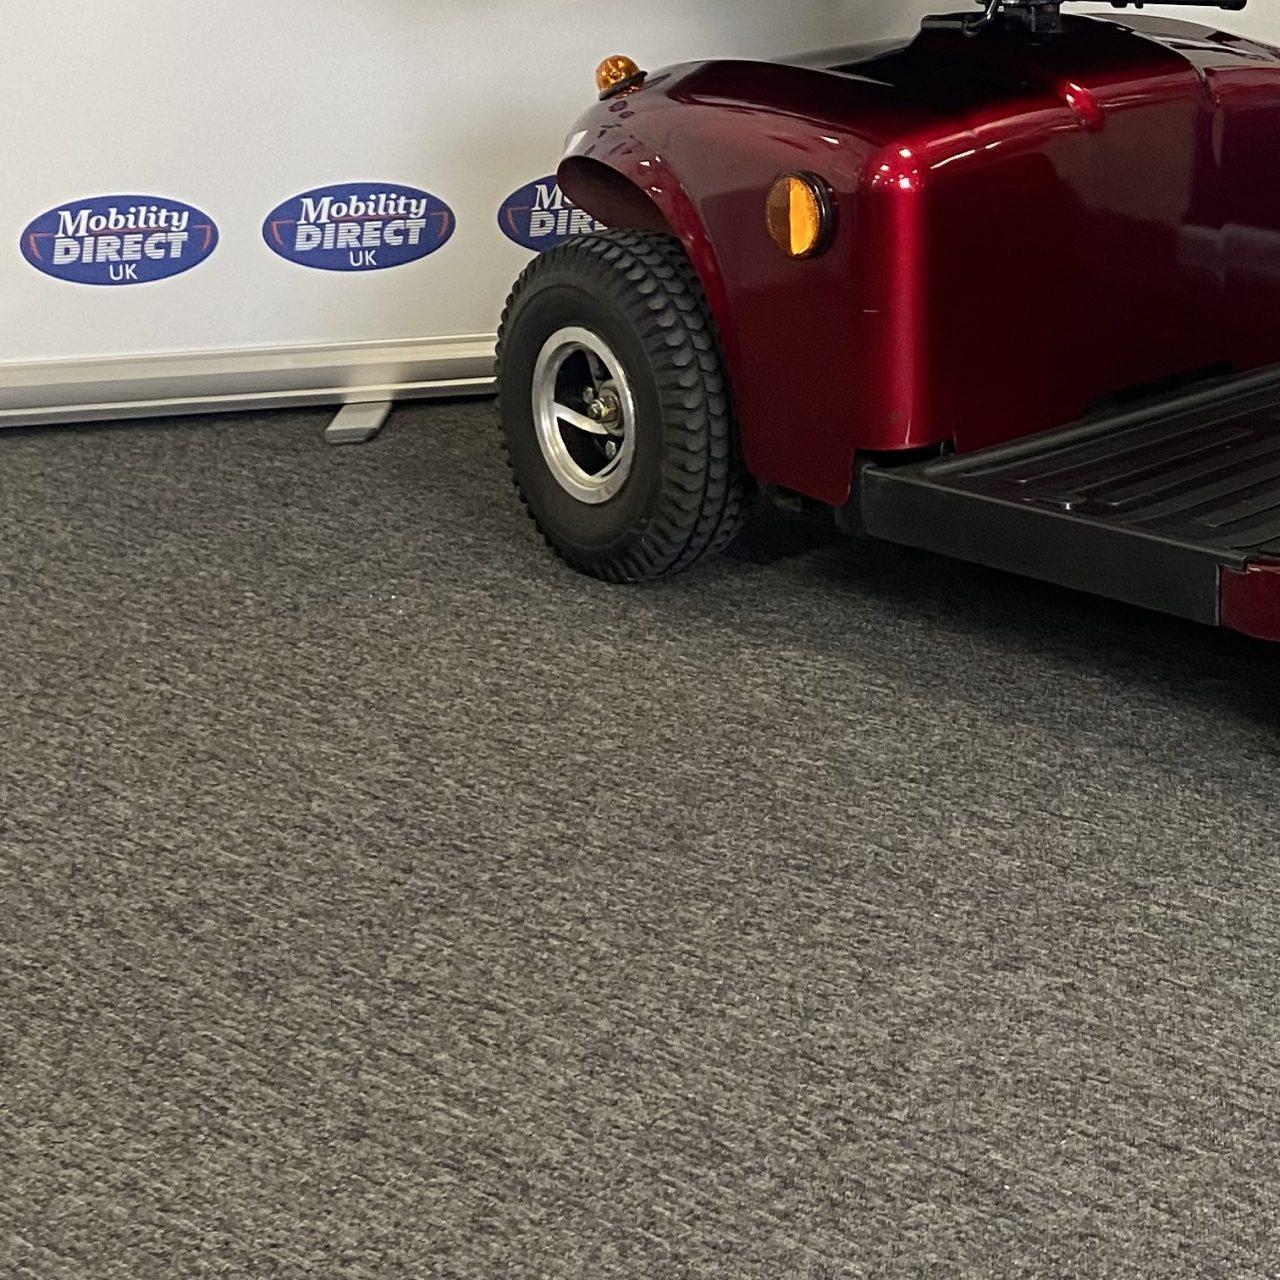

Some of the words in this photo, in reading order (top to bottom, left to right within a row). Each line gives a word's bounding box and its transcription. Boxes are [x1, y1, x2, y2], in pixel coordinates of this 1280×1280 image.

[55, 206, 188, 237] Mobility
[297, 194, 426, 224] Mobility
[529, 208, 608, 237] DIR
[54, 232, 188, 264] DIRECT
[296, 219, 426, 250] DIRECT
[110, 264, 137, 280] UK
[350, 250, 376, 266] UK
